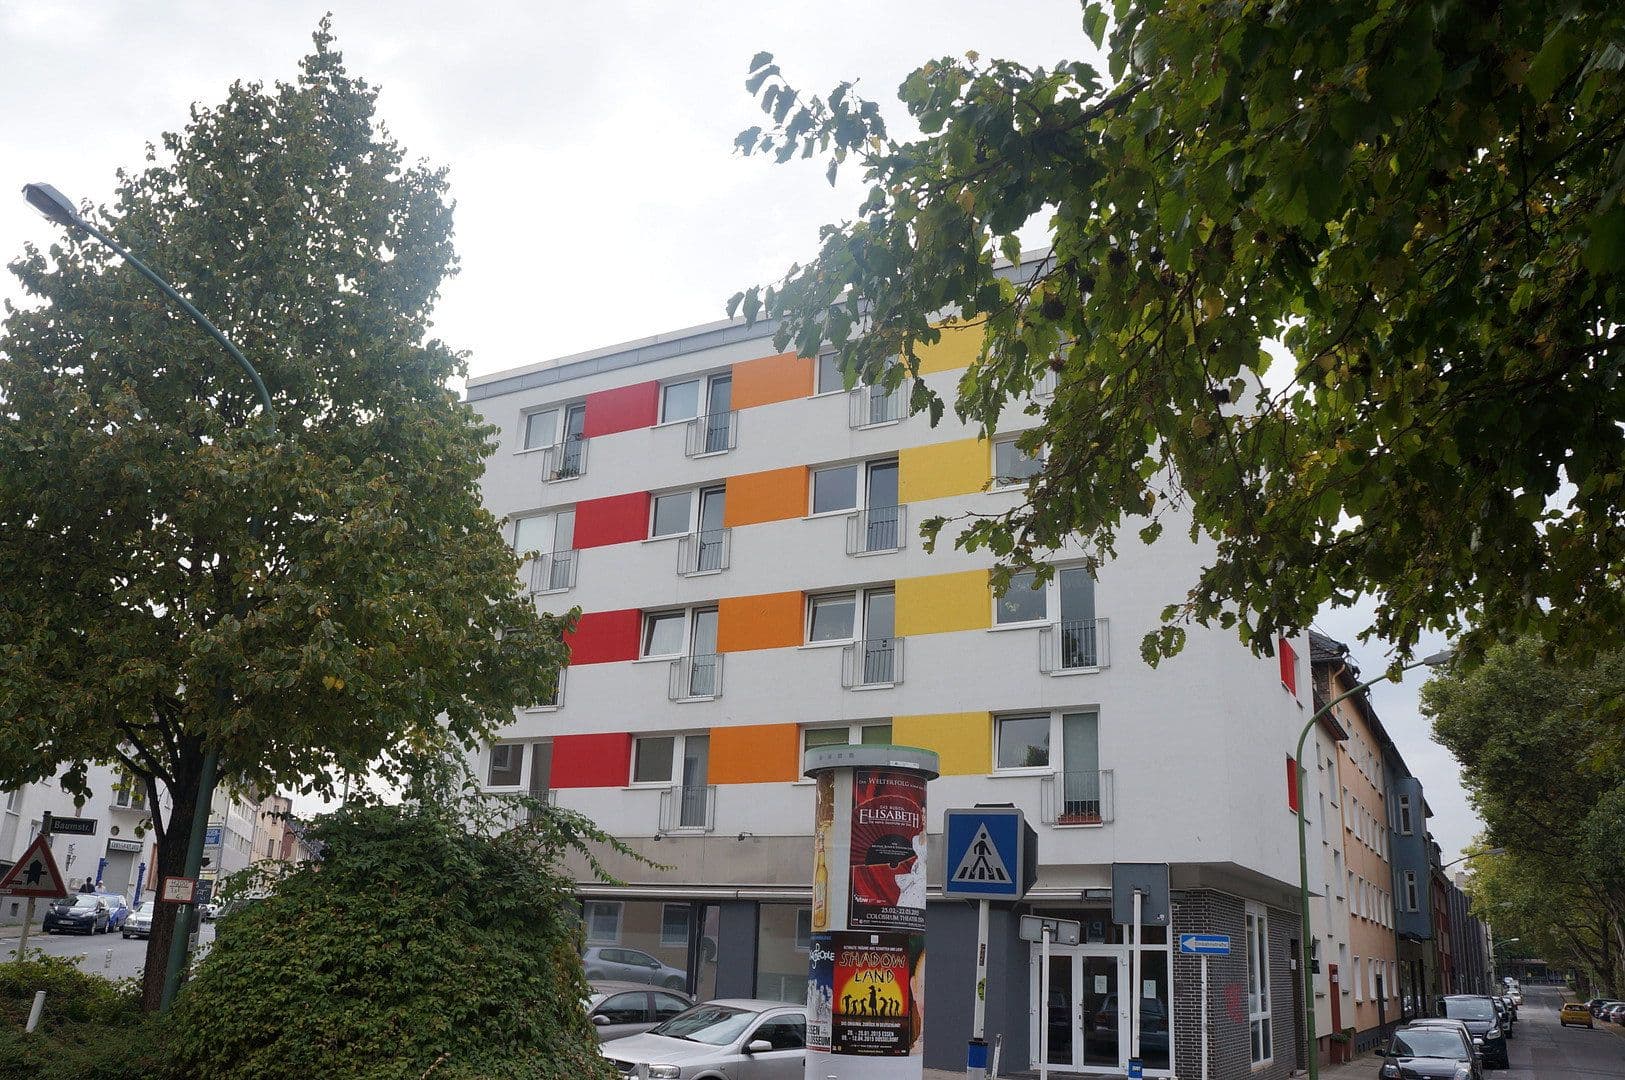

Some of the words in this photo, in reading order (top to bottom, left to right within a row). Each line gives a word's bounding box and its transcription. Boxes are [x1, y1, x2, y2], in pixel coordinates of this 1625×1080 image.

[54, 820, 91, 832] Baumstr.
[859, 808, 920, 829] ELISABETH
[839, 951, 906, 968] SHADOW
[855, 969, 896, 984] LAND
